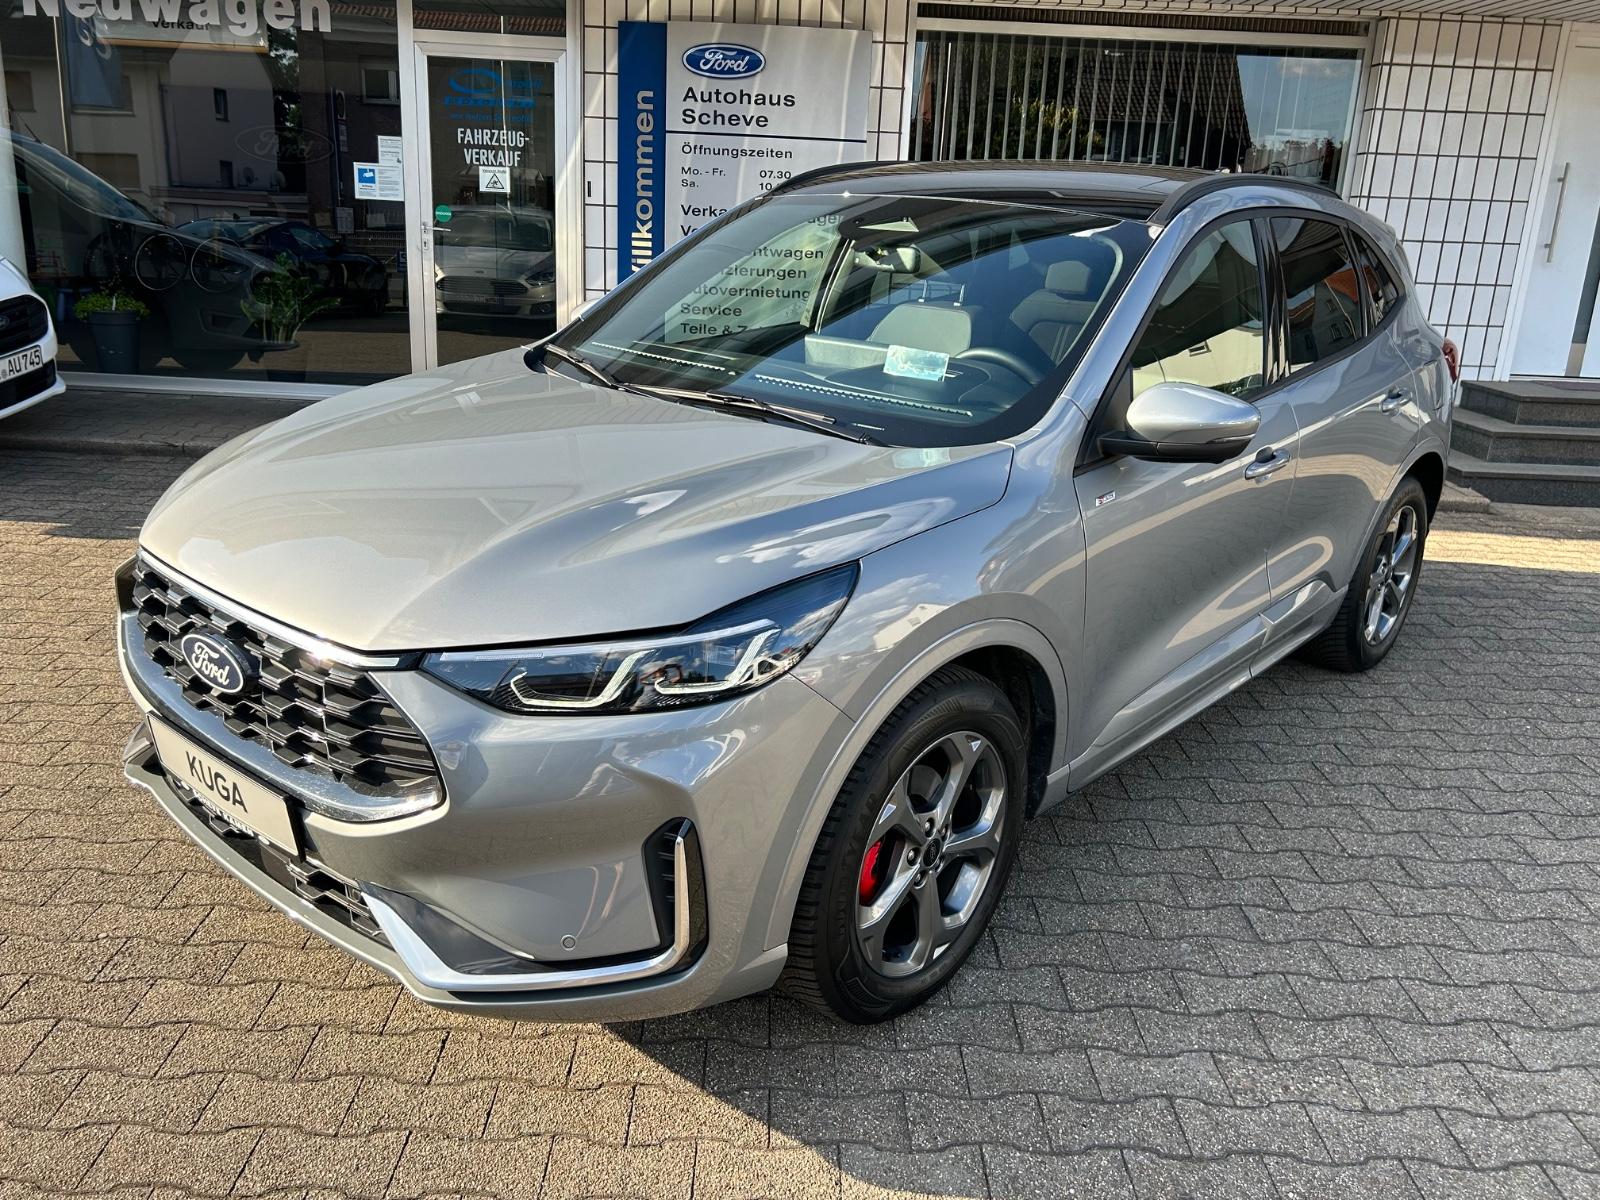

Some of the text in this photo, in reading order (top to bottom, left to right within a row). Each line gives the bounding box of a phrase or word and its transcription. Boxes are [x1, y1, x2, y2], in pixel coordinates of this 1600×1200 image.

[699, 48, 750, 72] Ford
[682, 86, 796, 107] Autohaus
[681, 108, 769, 128] Scheve
[457, 127, 530, 148] FAHRZEUG-
[463, 147, 522, 167] VERKAUF
[681, 141, 793, 159] Öffnungszeiten
[631, 90, 655, 273] illkommen
[680, 166, 702, 176] Mo.
[712, 167, 727, 177] Fr.
[759, 169, 792, 180] 07.30
[681, 179, 699, 188] Sa.
[721, 265, 807, 281] zierungen
[680, 302, 743, 317] Service
[680, 322, 717, 335] Teile
[721, 324, 733, 336] &
[191, 641, 230, 686] Ford
[185, 750, 249, 814] KUGA
